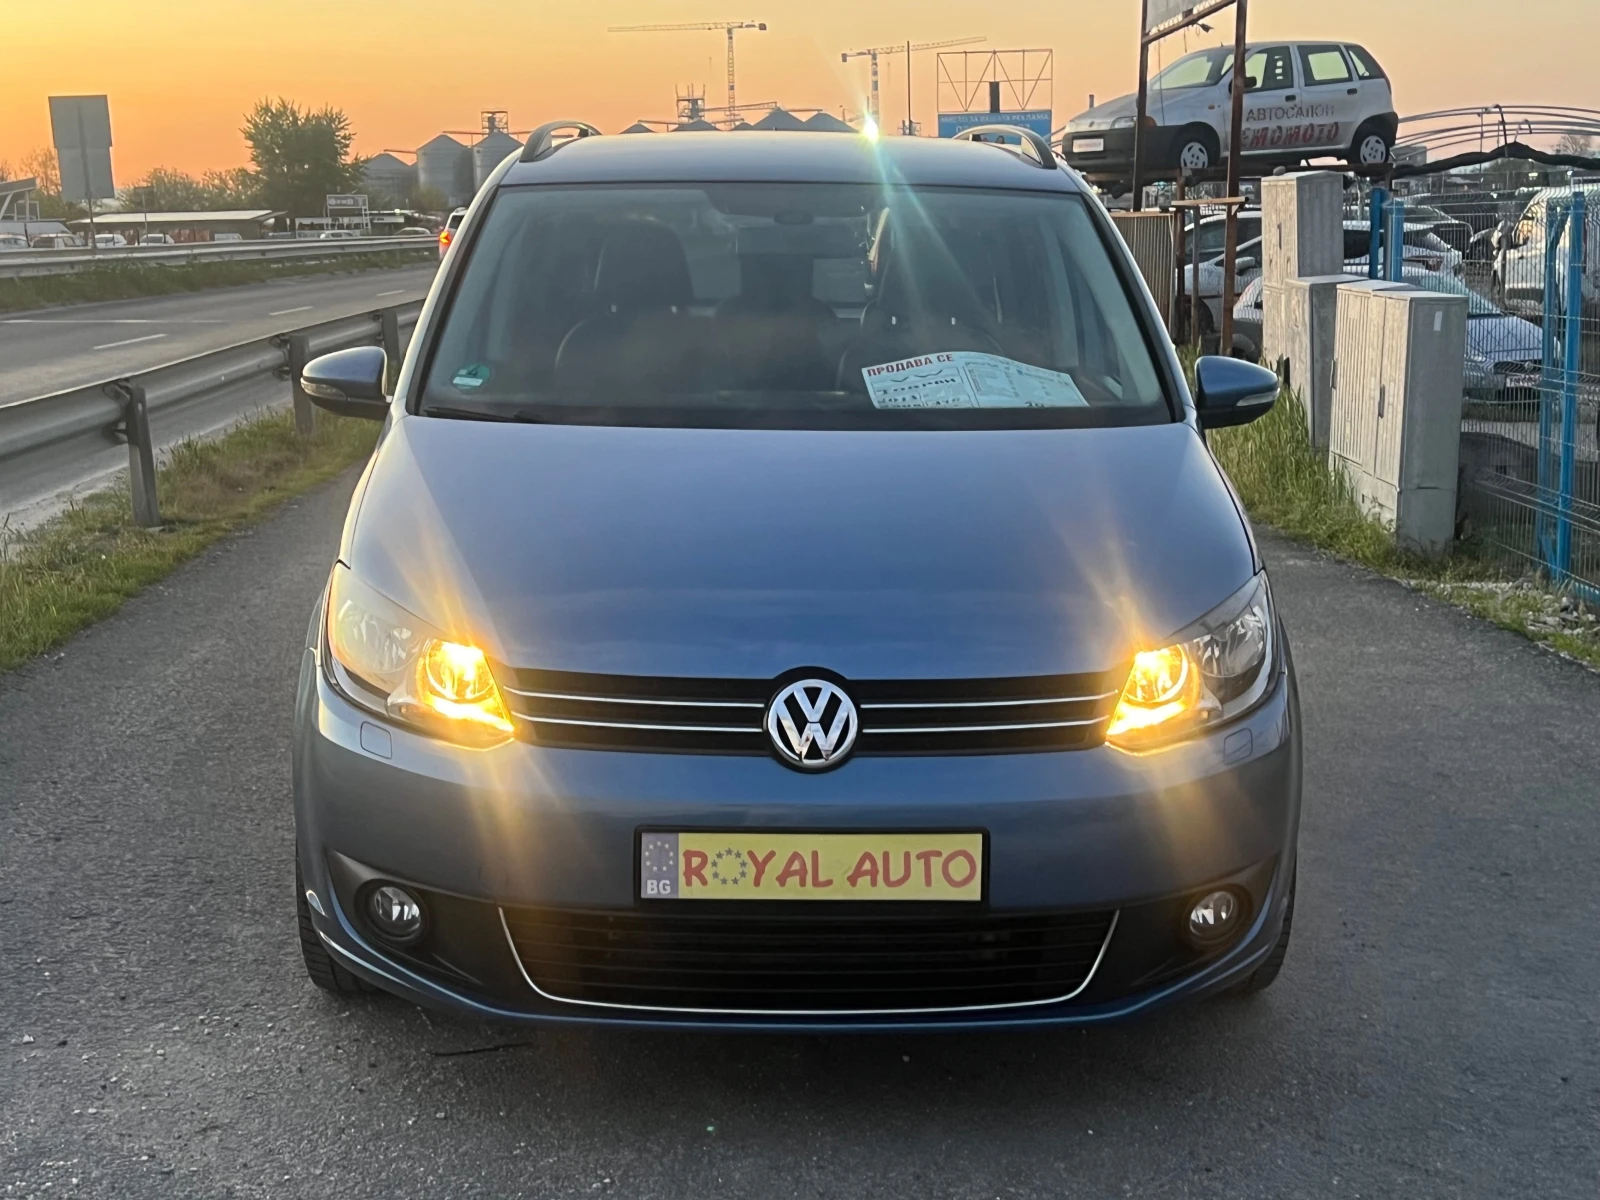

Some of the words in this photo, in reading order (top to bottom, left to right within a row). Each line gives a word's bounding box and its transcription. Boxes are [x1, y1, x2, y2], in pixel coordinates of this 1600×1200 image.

[1246, 104, 1335, 122] АВТОСАЛОН
[867, 356, 933, 377] ПРОДАВА
[936, 354, 954, 363] СЕ
[768, 678, 858, 765] VW
[846, 849, 977, 888] AUTO
[646, 879, 671, 895] BG
